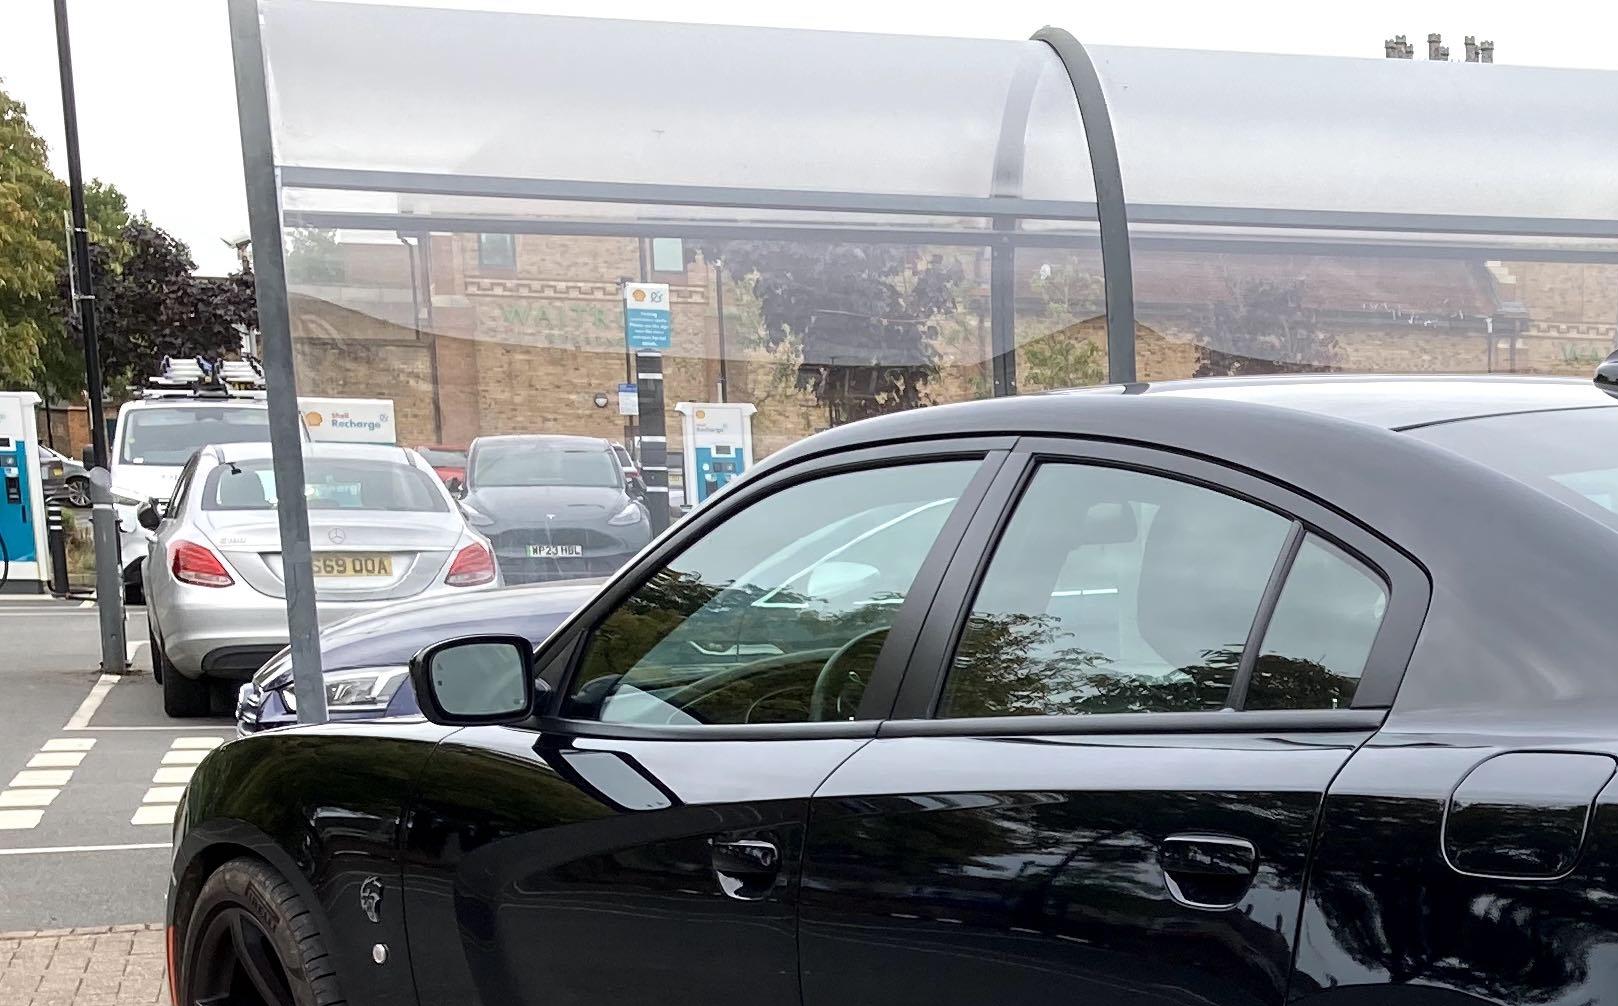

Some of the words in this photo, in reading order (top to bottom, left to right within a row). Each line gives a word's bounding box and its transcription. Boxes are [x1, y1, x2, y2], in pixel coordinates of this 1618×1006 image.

[503, 304, 612, 329] WAITR
[331, 419, 381, 431] Recharge
[313, 558, 347, 574] S69
